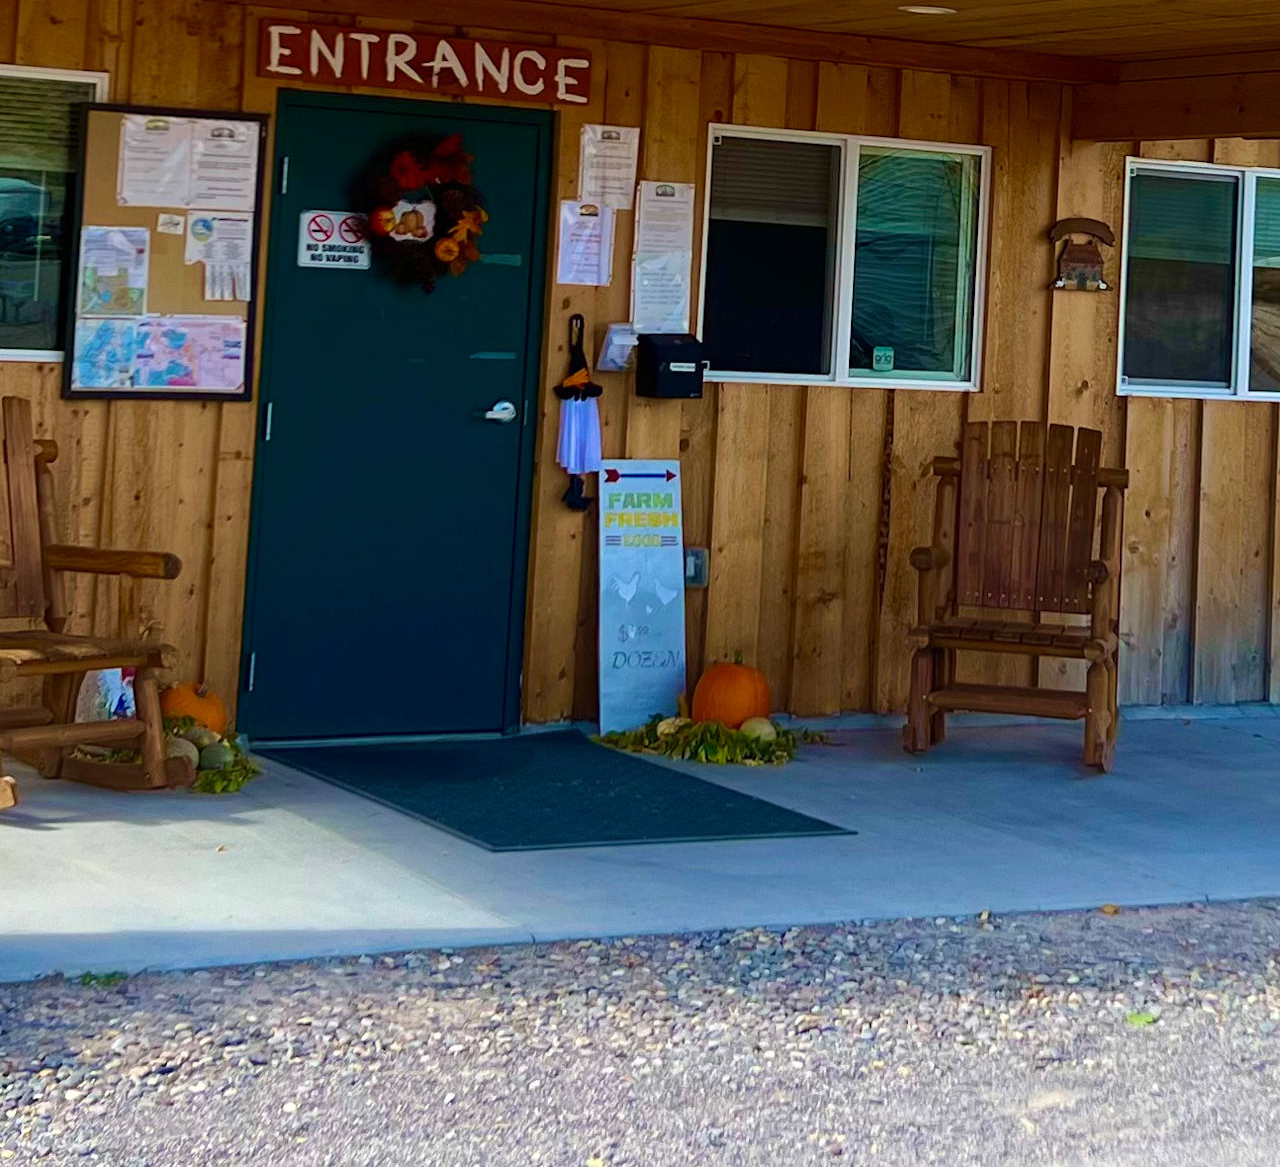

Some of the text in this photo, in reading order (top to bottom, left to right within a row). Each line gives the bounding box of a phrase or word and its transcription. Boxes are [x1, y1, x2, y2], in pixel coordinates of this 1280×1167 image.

[266, 25, 590, 104] ENTRANCE
[608, 492, 674, 509] FARM
[604, 511, 679, 528] FRESH
